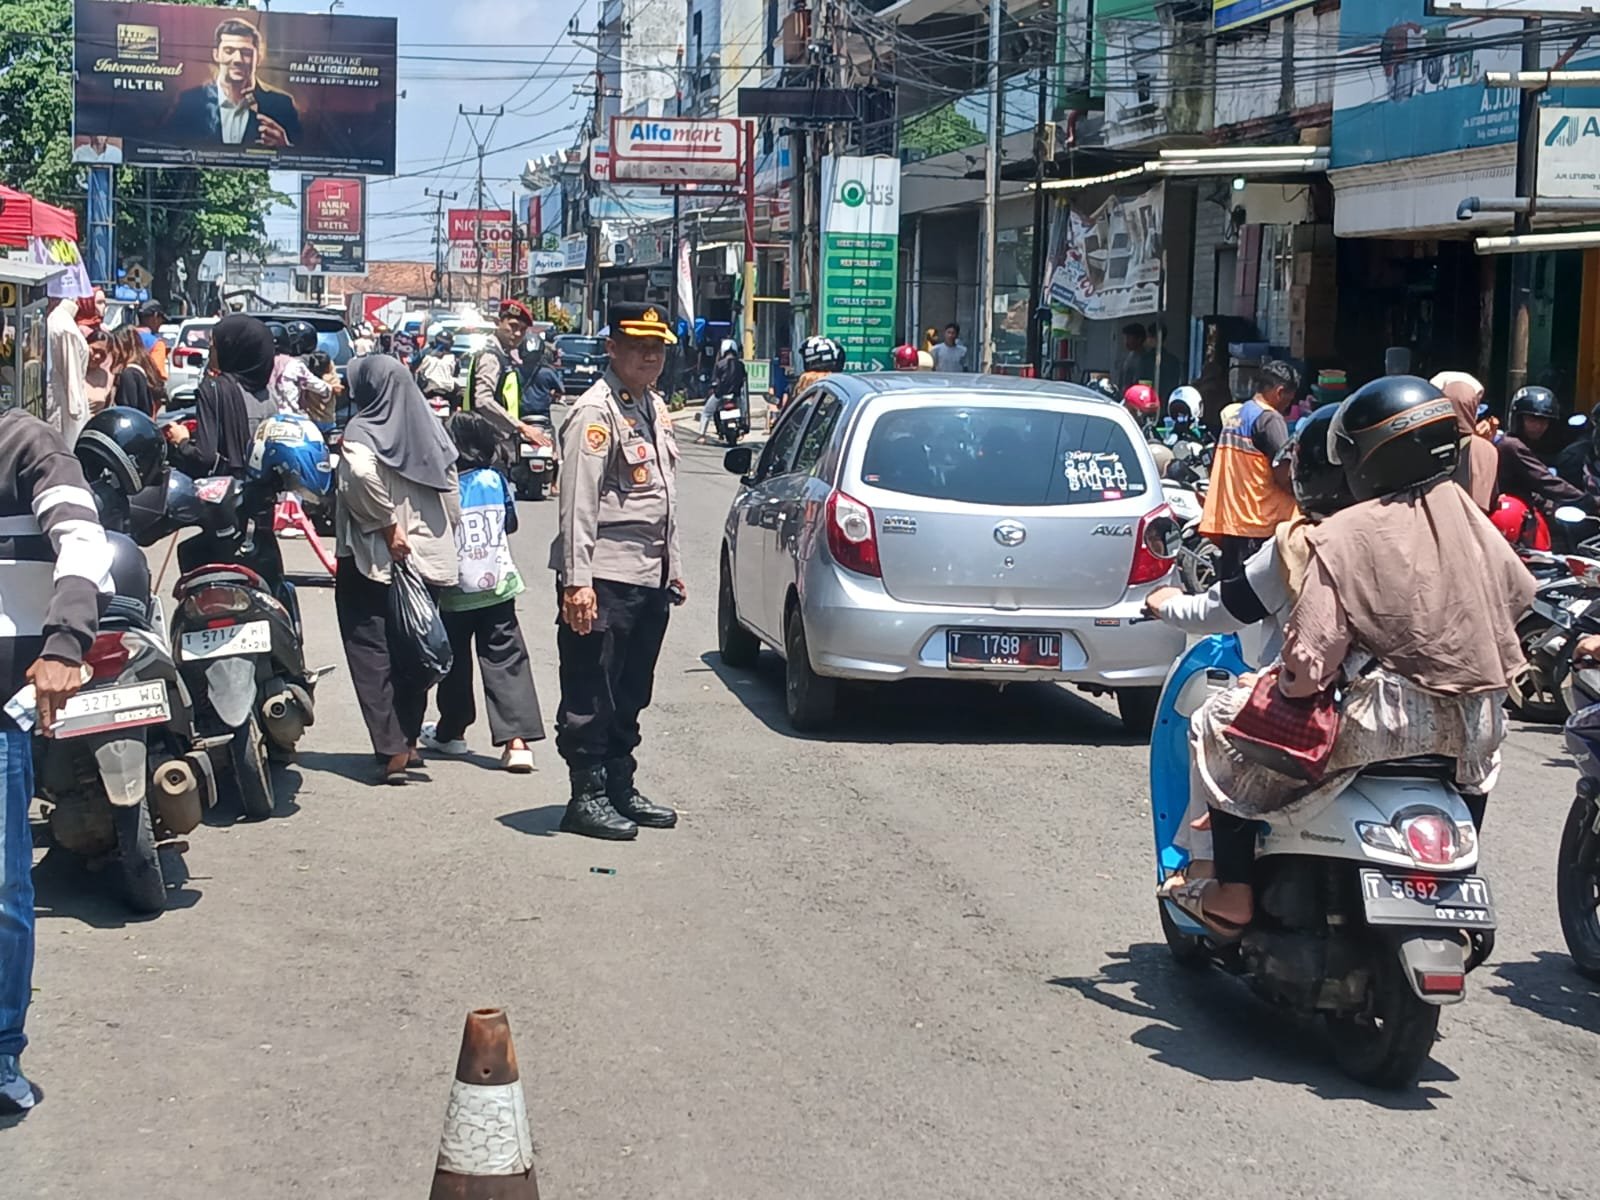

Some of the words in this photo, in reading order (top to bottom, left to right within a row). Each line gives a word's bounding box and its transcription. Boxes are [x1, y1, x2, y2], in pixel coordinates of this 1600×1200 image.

[93, 58, 184, 75] International
[318, 65, 379, 76] LEGENDARIS
[113, 78, 164, 91] FILTER
[629, 123, 723, 142] Alfamart
[853, 278, 867, 287] SPA
[1091, 524, 1133, 537] AYLA
[184, 634, 192, 645] T
[951, 633, 961, 654] T
[981, 634, 1020, 655] 1798
[1039, 637, 1059, 657] UL
[81, 693, 123, 713] 3275
[138, 686, 162, 702] WG
[1367, 879, 1380, 899] T
[1391, 880, 1440, 900] 5692
[1459, 882, 1482, 905] YT
